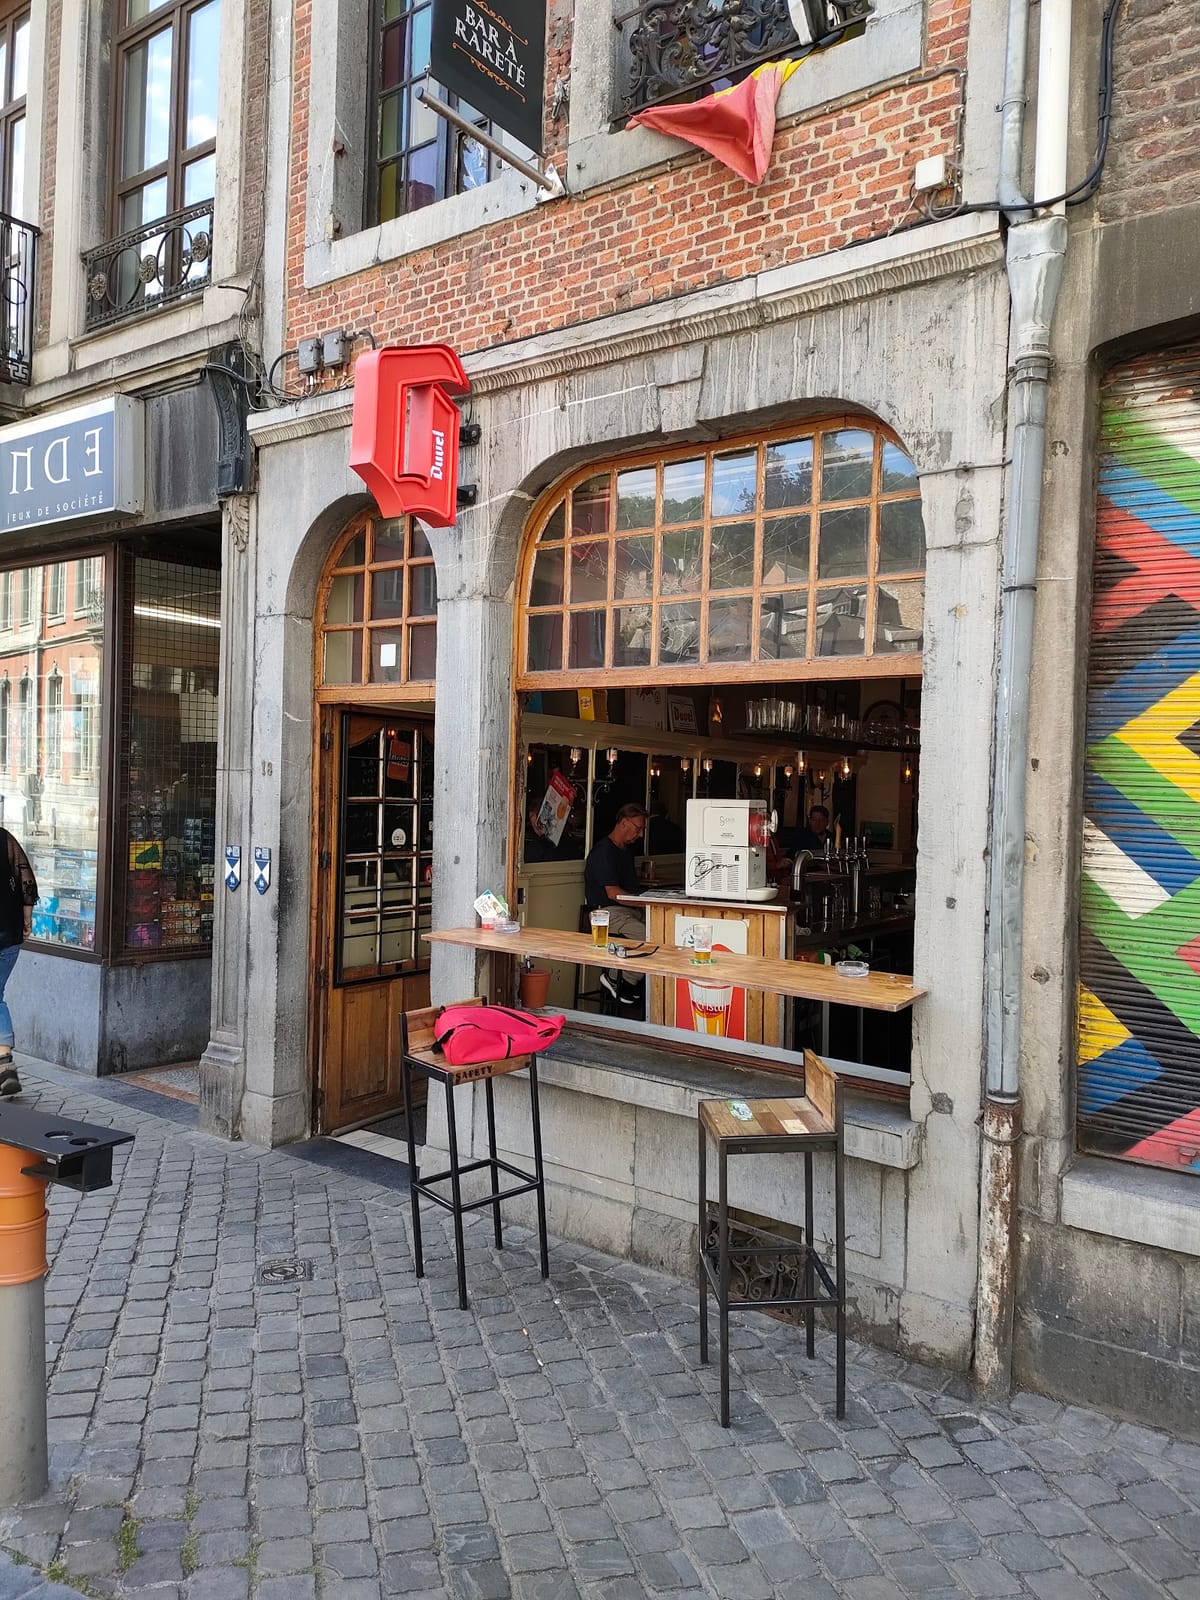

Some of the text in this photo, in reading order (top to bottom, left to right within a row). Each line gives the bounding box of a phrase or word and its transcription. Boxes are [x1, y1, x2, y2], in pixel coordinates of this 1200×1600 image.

[455, 17, 527, 88] RARETÉ
[465, 4, 518, 62] BAR À
[430, 429, 446, 481] Duvel
[37, 506, 50, 517] DE
[455, 1064, 493, 1081] SAFETY
